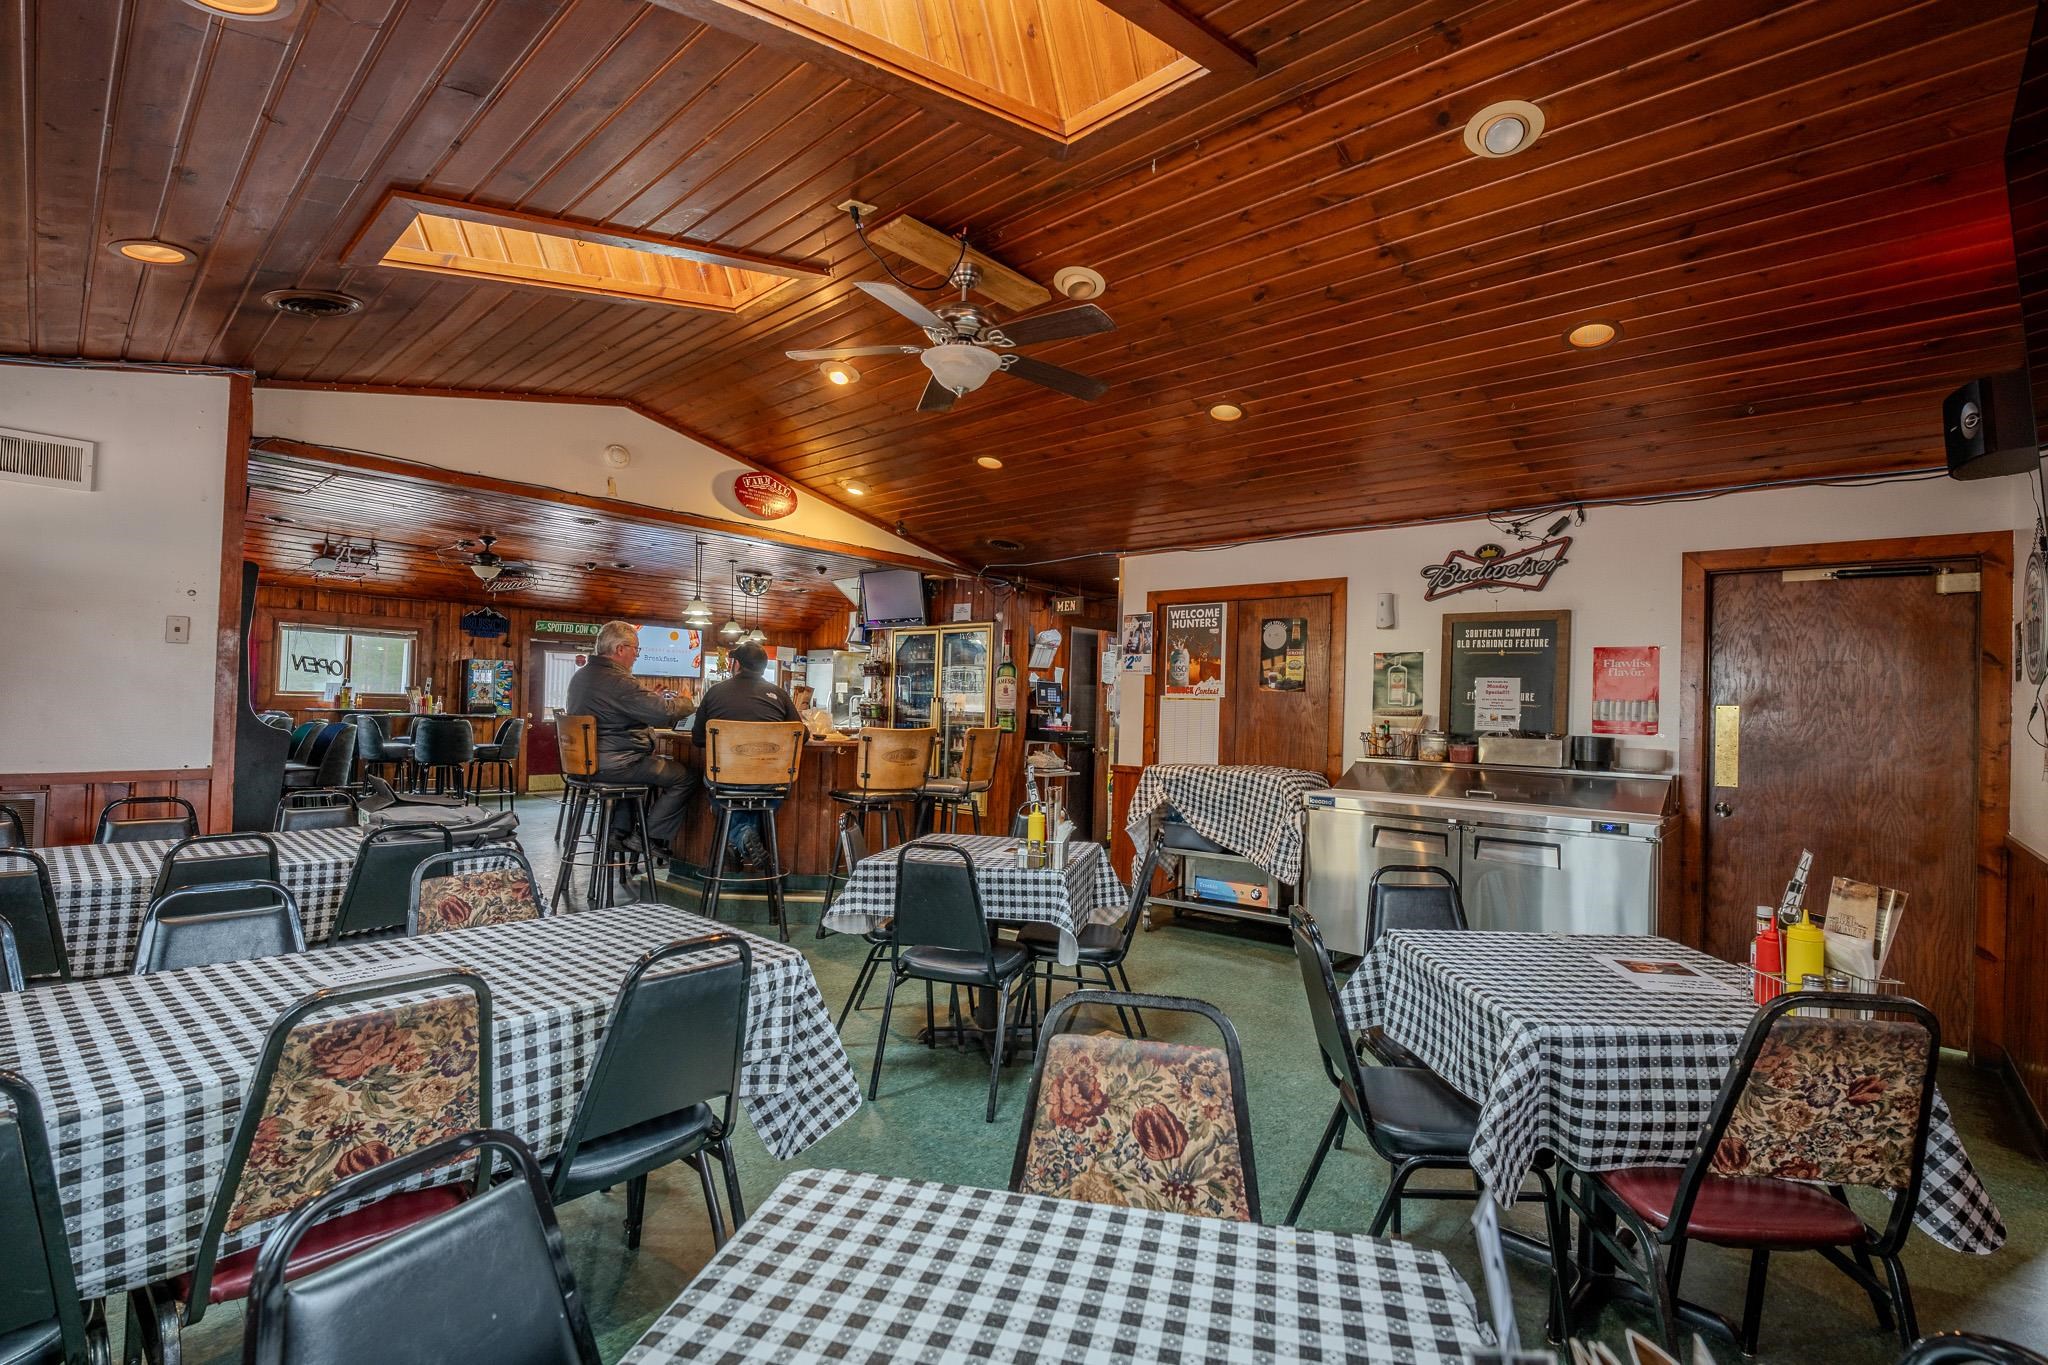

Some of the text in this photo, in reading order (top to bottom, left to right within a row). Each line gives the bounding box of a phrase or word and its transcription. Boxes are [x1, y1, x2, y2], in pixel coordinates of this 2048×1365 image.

[1421, 557, 1568, 588] Budweiser
[1057, 601, 1076, 611] MEN
[1170, 608, 1220, 619] WELCOME
[547, 623, 574, 632] SPOTTED
[576, 625, 589, 633] COW
[1172, 618, 1217, 628] HUNTERS
[1465, 628, 1540, 638] SOUTHERN COMFORT
[1457, 638, 1550, 648] OLD FASHIONED FEATURE
[1195, 687, 1219, 696] Contest
[1799, 856, 1810, 881] 4
